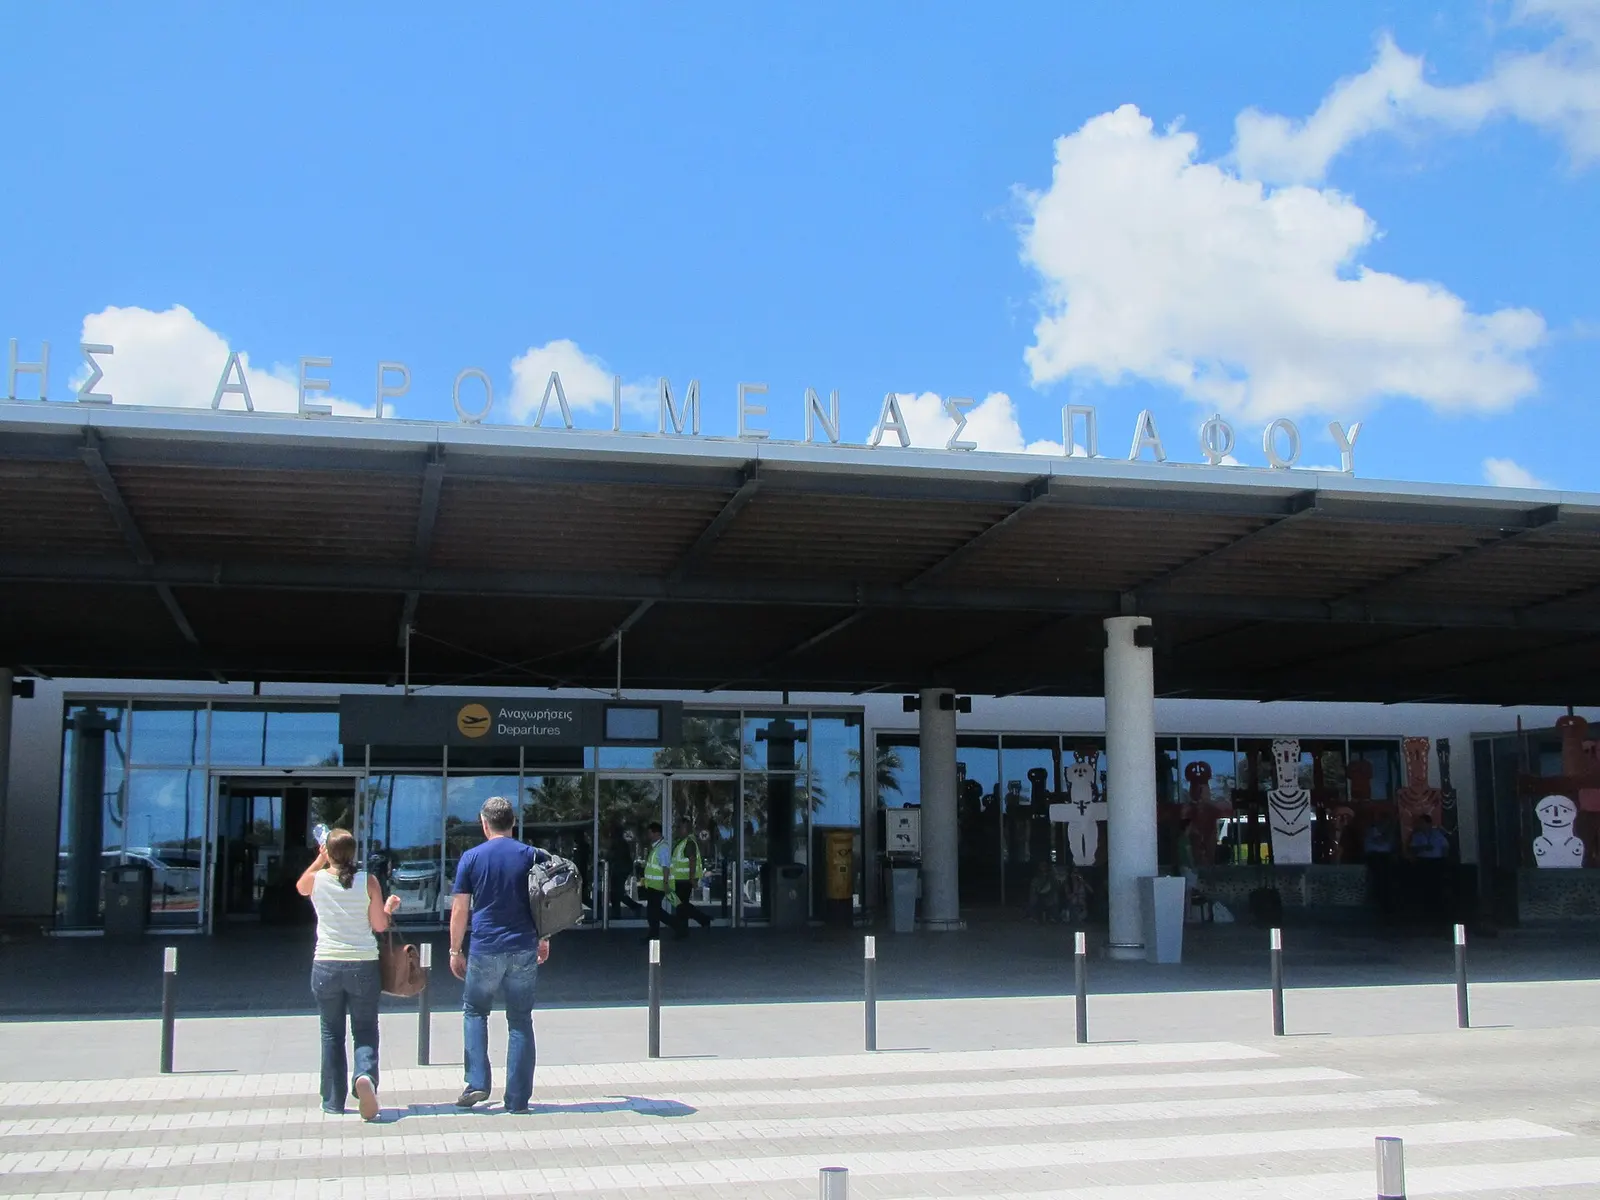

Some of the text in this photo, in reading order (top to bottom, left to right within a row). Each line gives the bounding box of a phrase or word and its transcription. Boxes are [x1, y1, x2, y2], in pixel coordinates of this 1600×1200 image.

[211, 351, 977, 451] ΑΕΡΟΛΙΜΕΝΑΣ
[1060, 403, 1363, 472] ΠΑΦΟΥ
[498, 707, 573, 721] Αναχωρήσεις
[497, 724, 561, 736] Departures
